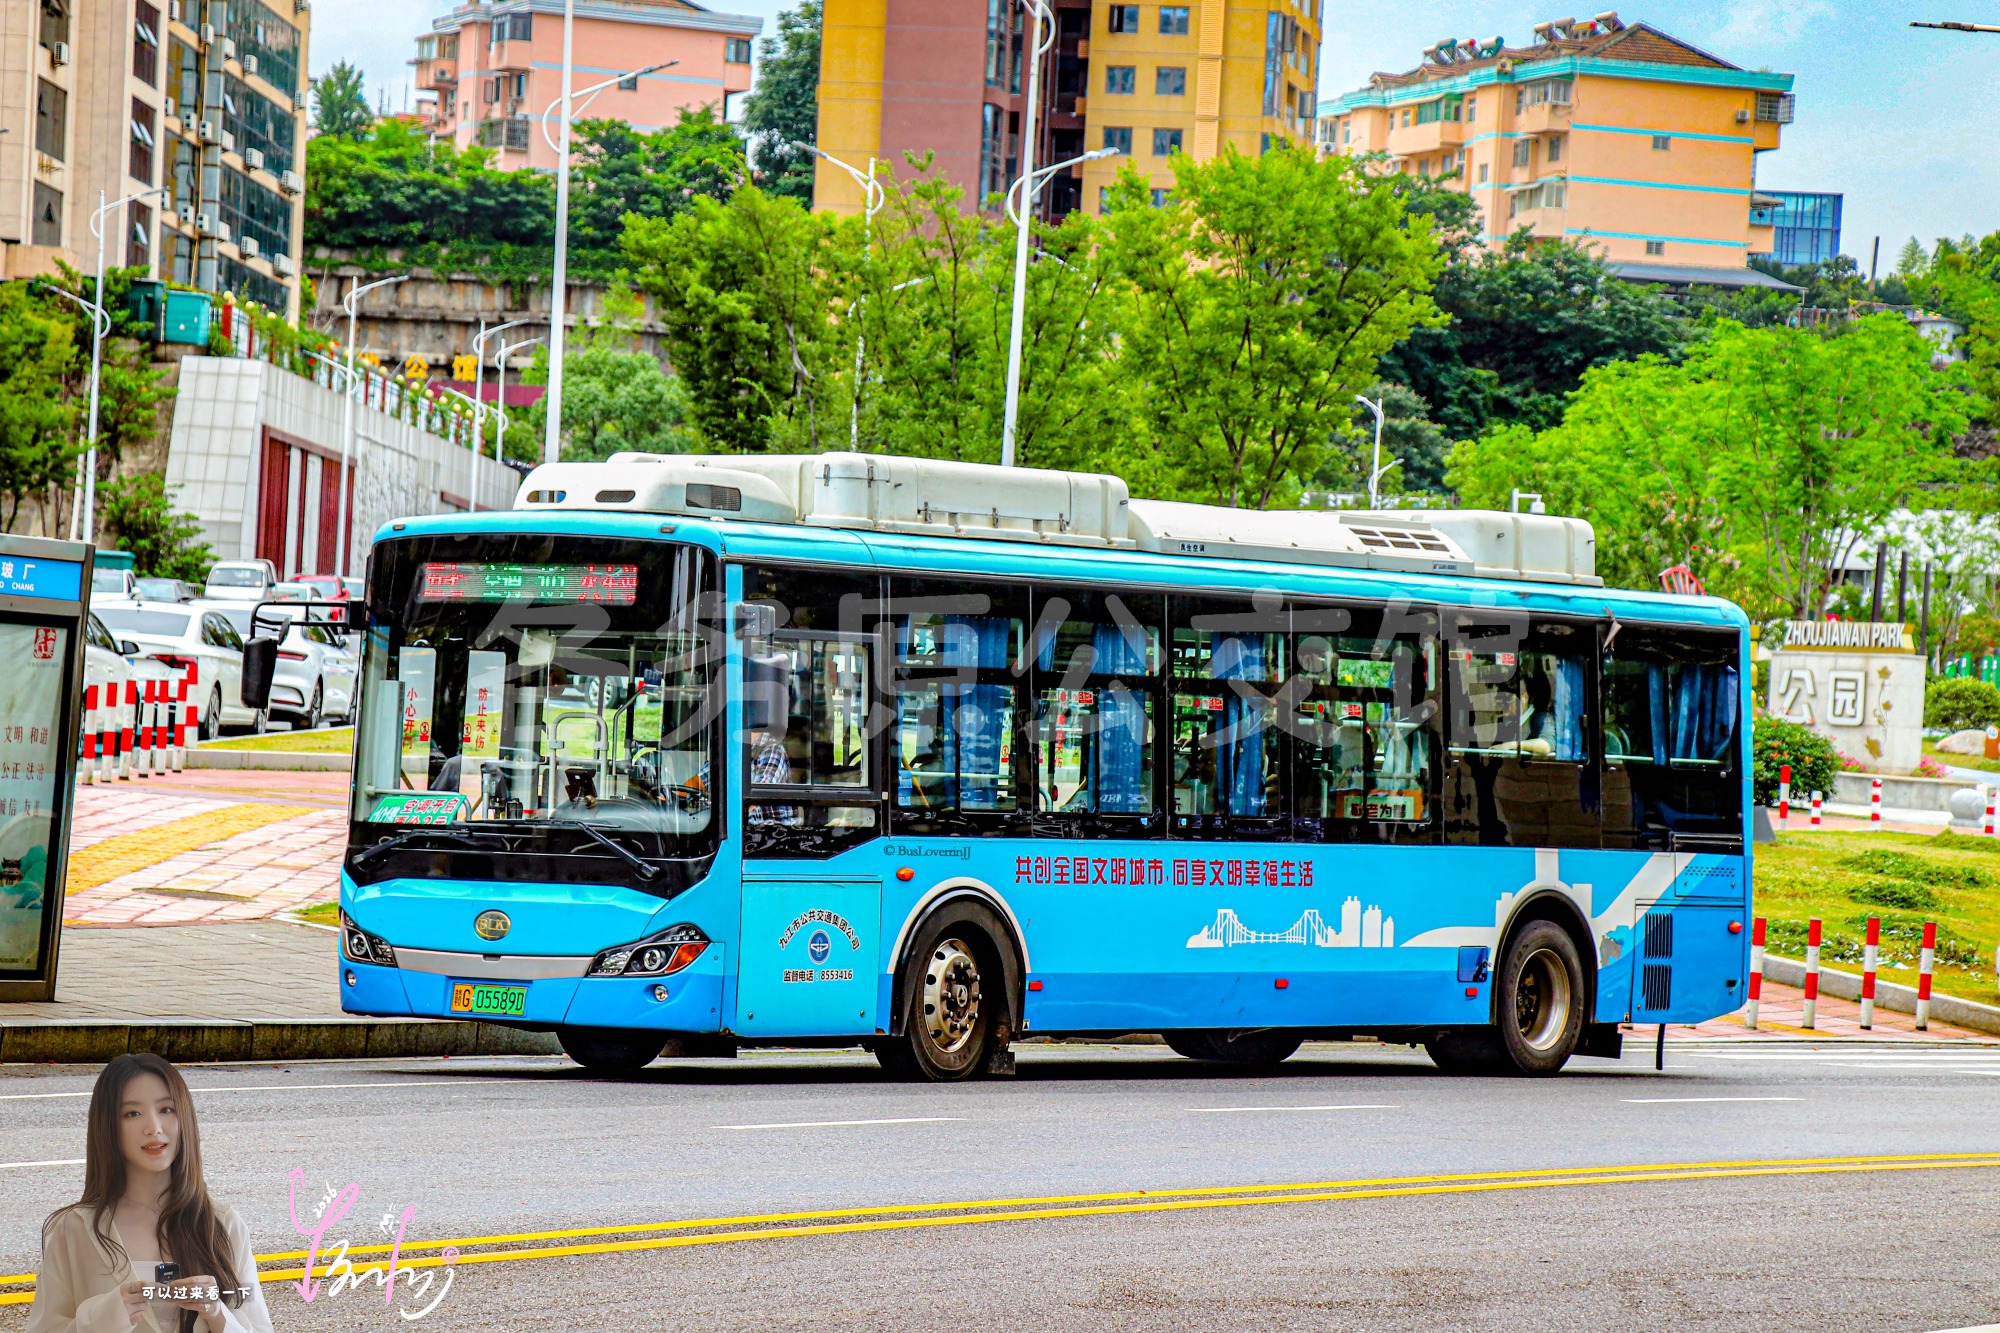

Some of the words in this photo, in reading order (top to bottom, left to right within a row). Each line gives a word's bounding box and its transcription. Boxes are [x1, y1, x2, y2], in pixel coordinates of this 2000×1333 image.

[12, 582, 35, 592] CHANG
[1784, 619, 1870, 647] ZHOUJIAWAN
[1871, 622, 1905, 649] PARK
[1778, 668, 1866, 727] 公园
[402, 687, 418, 749] 小心开门
[475, 687, 489, 749] 防止夹伤
[4, 725, 24, 744] 文明
[30, 726, 49, 745] 和谐
[1, 762, 21, 780] 公正
[26, 762, 45, 781] 法治
[401, 798, 460, 814] 空调开启
[778, 908, 861, 951] 九江市公共交通集团公司
